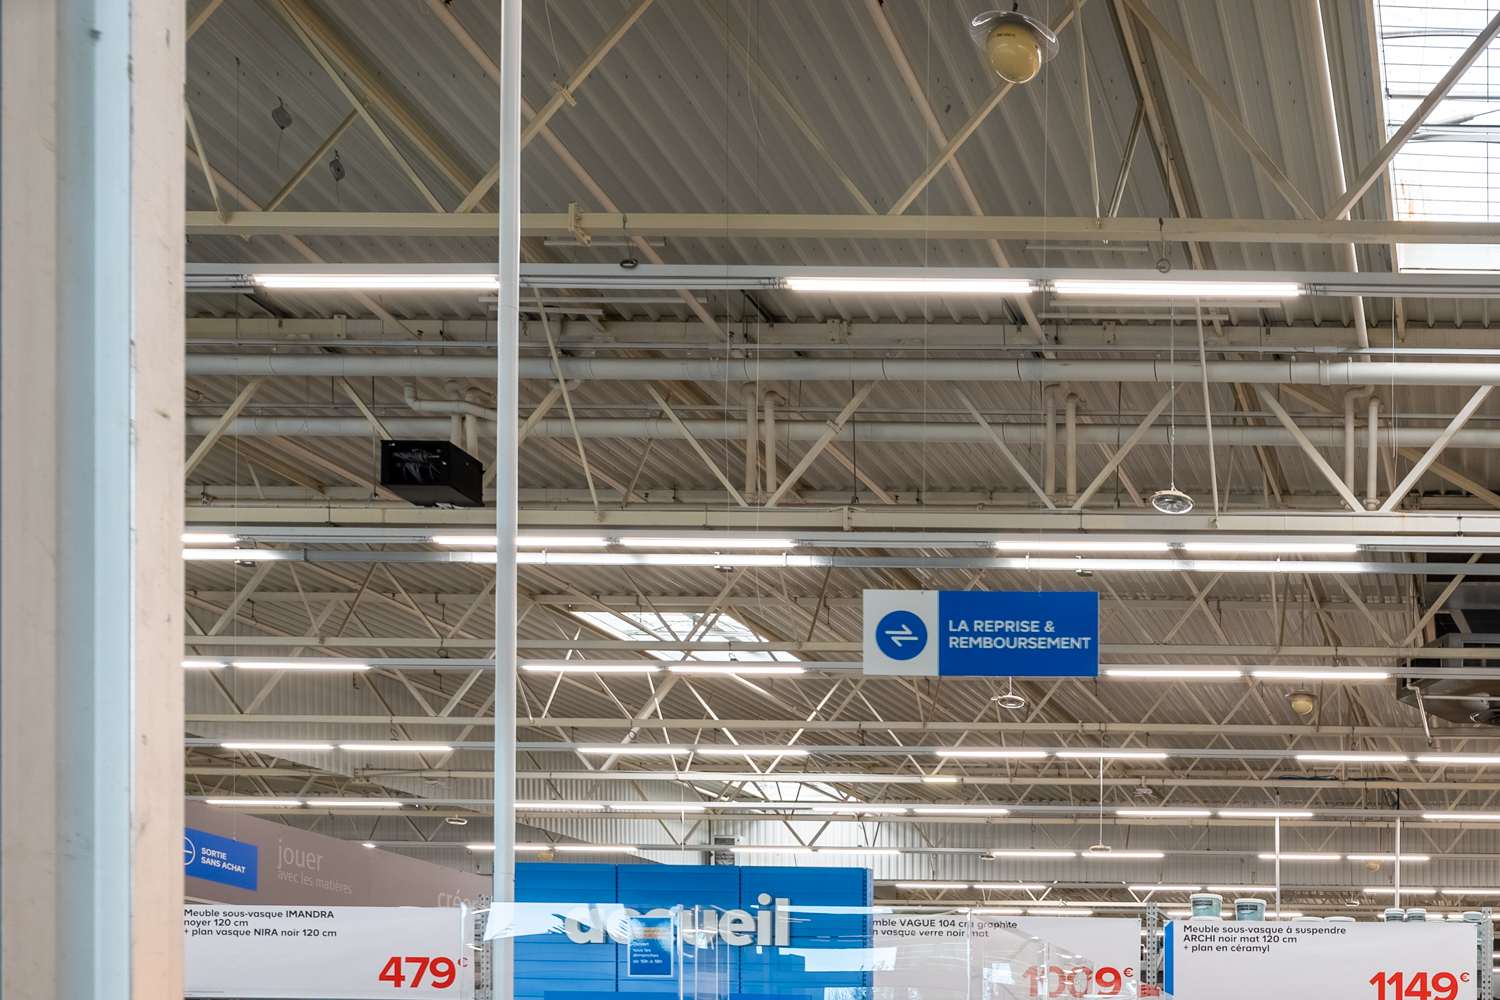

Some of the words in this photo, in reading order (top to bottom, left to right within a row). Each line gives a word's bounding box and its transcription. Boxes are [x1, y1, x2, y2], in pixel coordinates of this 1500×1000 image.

[948, 620, 970, 632] LA
[973, 620, 1040, 633] REPRISE
[1043, 620, 1055, 633] &
[949, 636, 1092, 650] REMBOURSEMENT
[201, 847, 227, 860] SORTIE
[277, 839, 323, 871] jouer
[201, 856, 221, 868] SANS
[222, 862, 246, 873] ACHAT
[277, 870, 299, 883] avec
[301, 872, 313, 886] les
[316, 874, 353, 895] matières
[184, 909, 220, 918] Meuble
[222, 910, 283, 919] sous-vasque
[285, 910, 335, 919] IMANDRA
[184, 919, 211, 928] noyer
[899, 919, 936, 927] VAGUE
[977, 921, 1018, 929] graphite
[192, 929, 213, 937] plan
[302, 929, 320, 937] 120
[946, 929, 964, 937] noir
[1183, 925, 1220, 934] Meuble
[1222, 925, 1284, 936] sous-vasque
[1286, 925, 1293, 934] à
[1295, 926, 1347, 937] suspendre
[1183, 934, 1216, 943] ARCHI
[1218, 934, 1238, 943] noir
[1240, 934, 1260, 943] mat
[1262, 934, 1280, 943] 120
[1191, 944, 1214, 953] plan
[1230, 943, 1270, 953] céramyl
